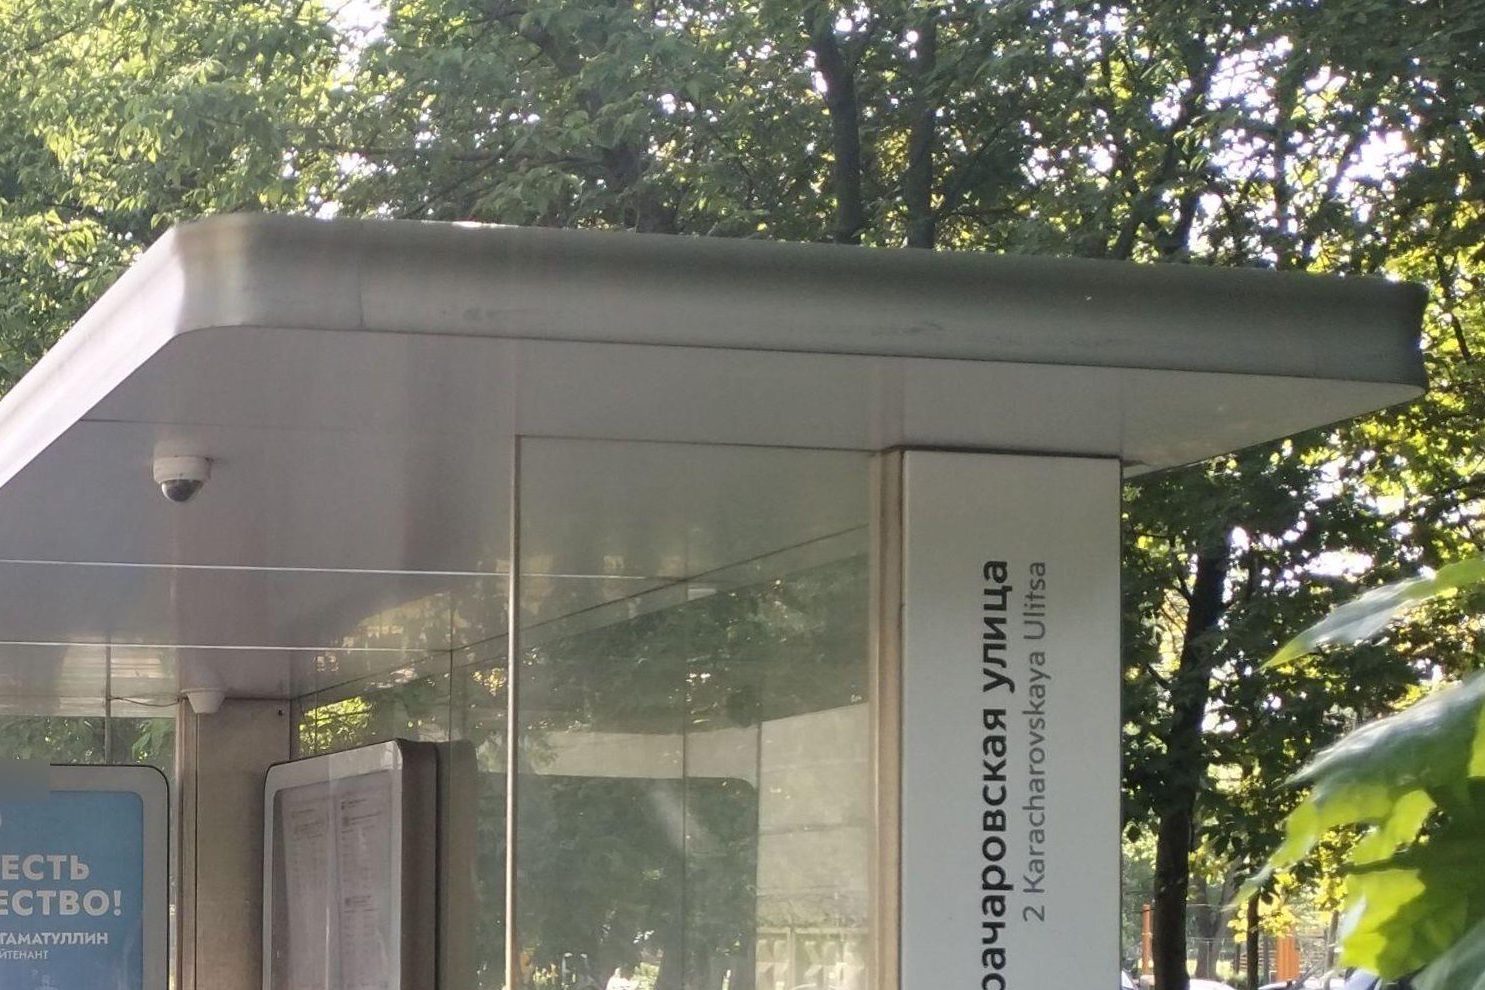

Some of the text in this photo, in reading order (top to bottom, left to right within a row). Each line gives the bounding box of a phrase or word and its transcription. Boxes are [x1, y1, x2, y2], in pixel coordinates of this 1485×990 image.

[982, 560, 1015, 693] улица
[1022, 561, 1052, 922] 2 Karacharovskaya Ulitsa
